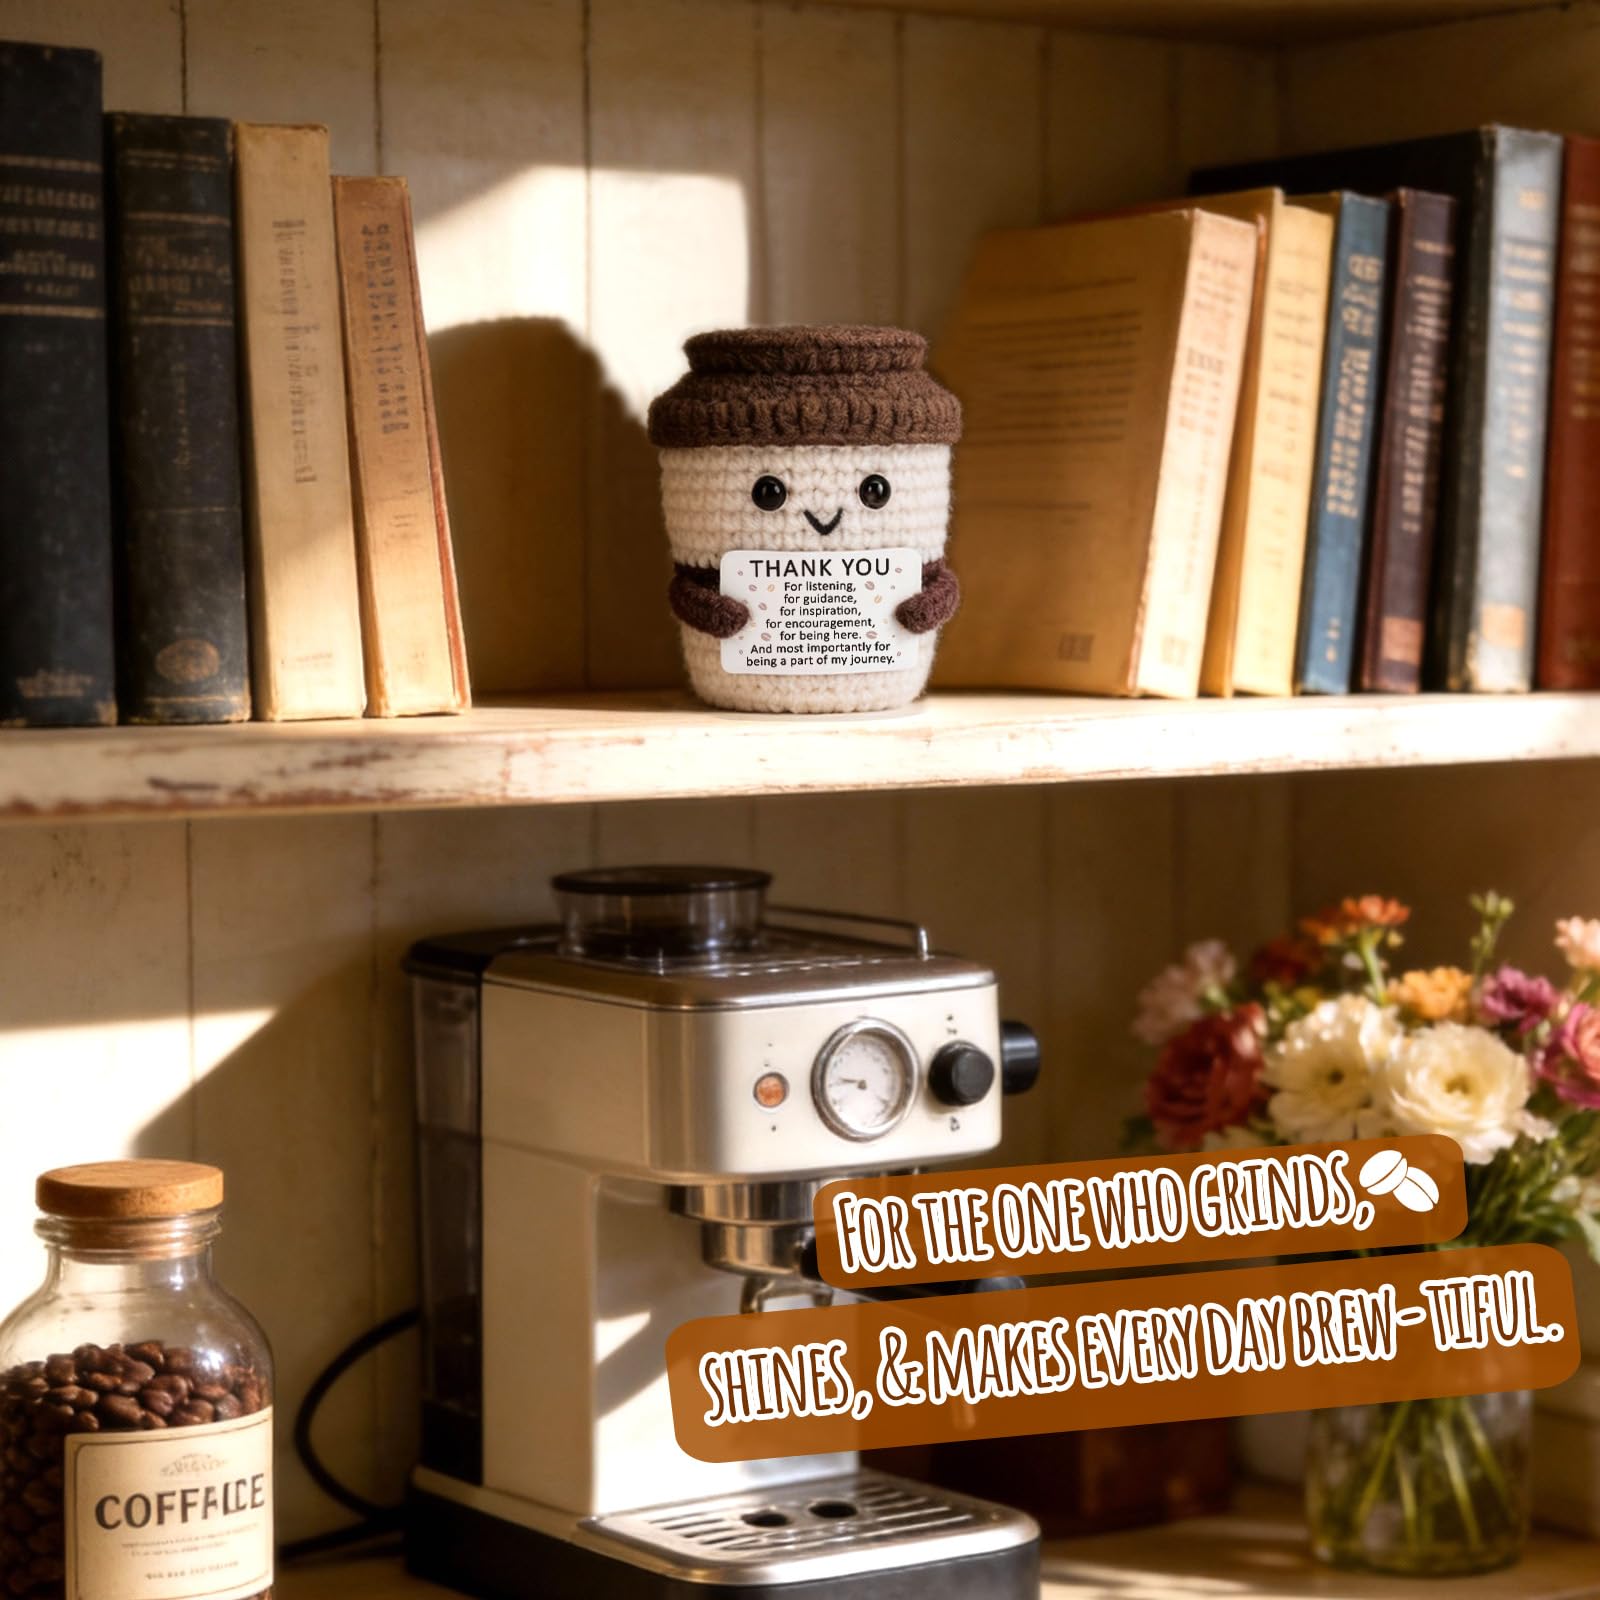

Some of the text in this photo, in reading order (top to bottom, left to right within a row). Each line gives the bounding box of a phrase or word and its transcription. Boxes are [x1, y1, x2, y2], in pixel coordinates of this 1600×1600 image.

[749, 558, 890, 578] THANK YOU
[784, 580, 856, 592] For listening,
[784, 593, 857, 605] for guidance,
[780, 605, 862, 617] for inspiration,
[766, 617, 876, 629] for encouragement,
[780, 629, 862, 642] for being here.
[750, 641, 891, 655] And most importantly for
[746, 654, 895, 667] being a part of my journey.
